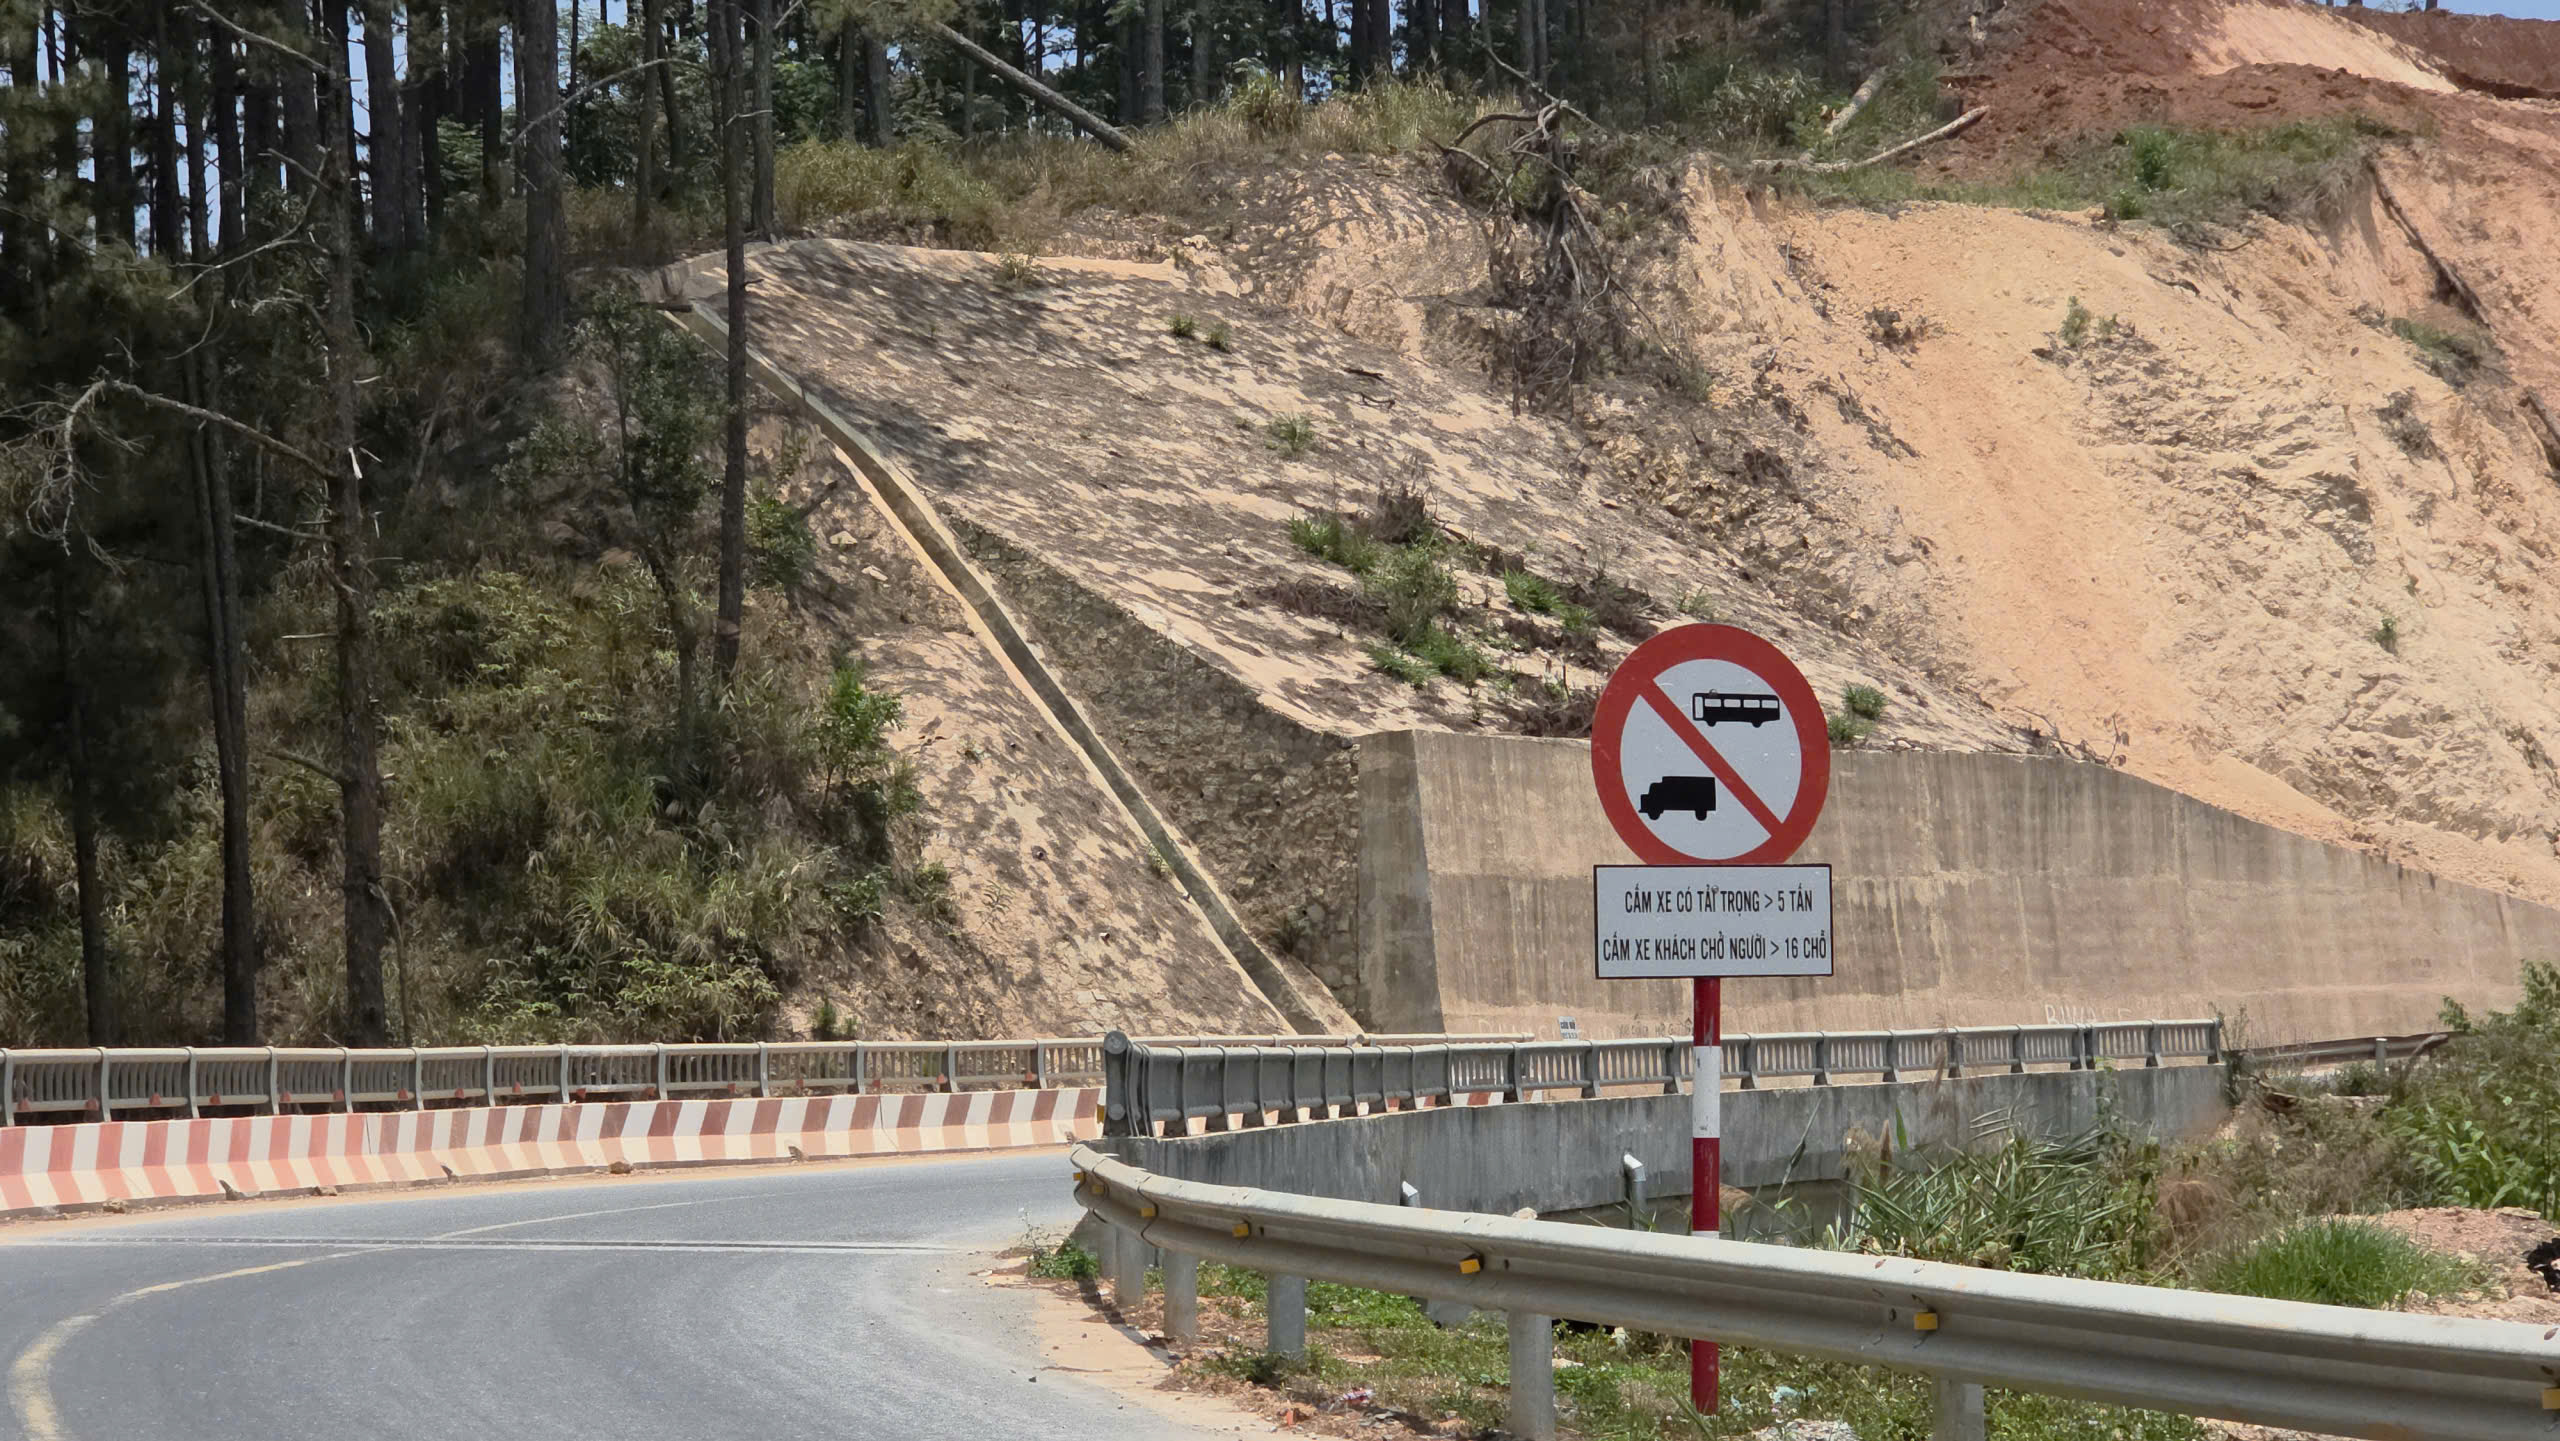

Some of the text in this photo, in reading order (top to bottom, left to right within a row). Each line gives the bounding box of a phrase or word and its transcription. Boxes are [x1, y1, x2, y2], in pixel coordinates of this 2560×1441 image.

[1625, 883, 1813, 917] CẤM XE CÓ TẢI TRỌNG > 5 TẤN
[1603, 929, 1827, 962] CẤM XE KHÁCH CHỞ NGƯỜI > 16 CHỖ
